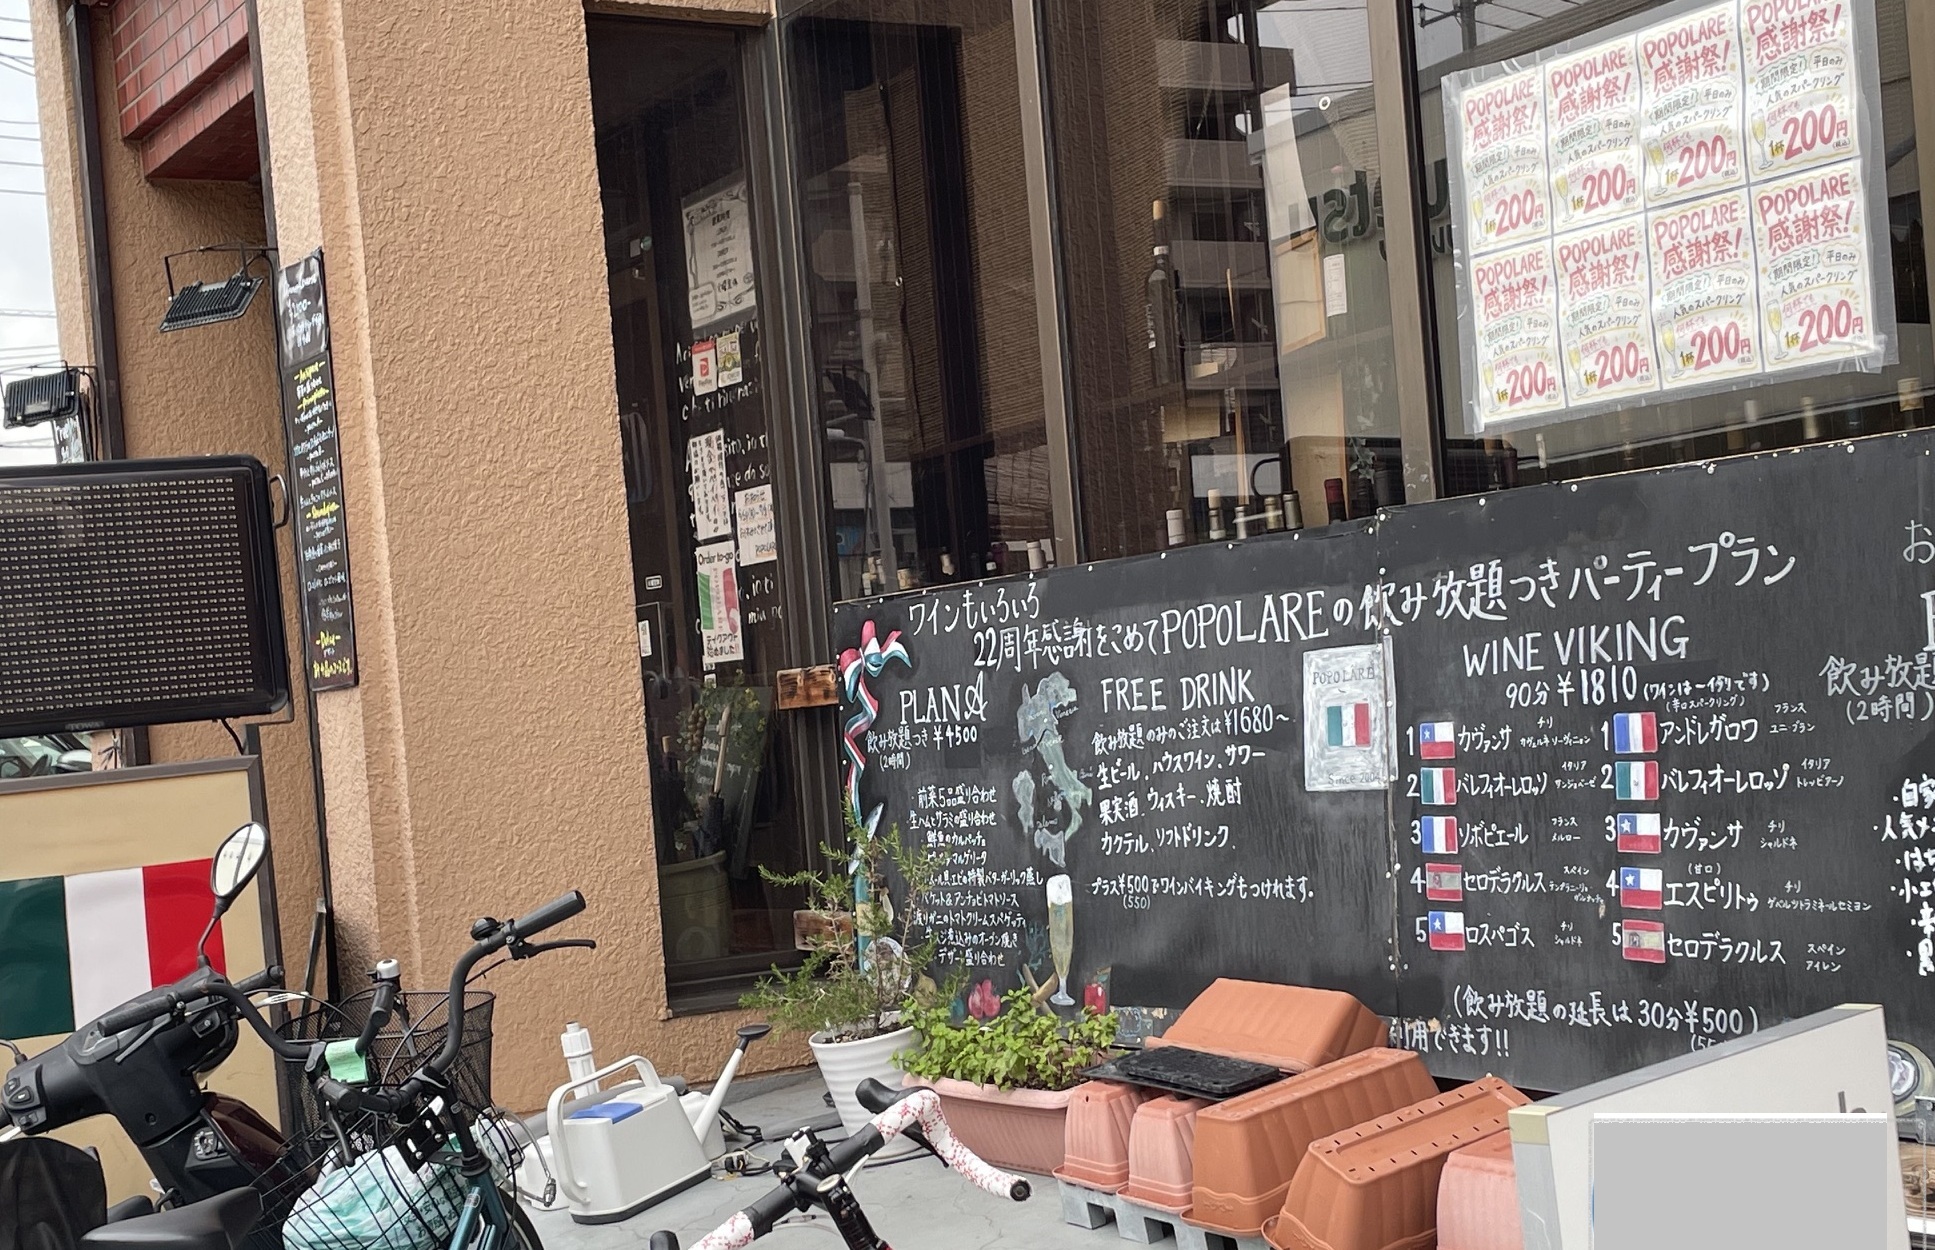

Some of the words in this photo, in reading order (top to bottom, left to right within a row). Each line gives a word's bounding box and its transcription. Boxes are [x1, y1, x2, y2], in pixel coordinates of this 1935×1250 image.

[1643, 13, 1726, 68] POPOLARE
[1756, 4, 1841, 66] 感謝祭!
[1551, 47, 1627, 98] POPOLARE
[1654, 39, 1730, 97] 感謝祭!
[1813, 55, 1844, 68] 平日のみ
[1465, 78, 1535, 126] POPOLARE
[1558, 72, 1631, 127] 感謝祭!
[1704, 89, 1732, 100] 平日のみ
[1766, 73, 1845, 106] 人気のスパークリング
[1473, 101, 1537, 152] 感謝祭!
[1605, 118, 1631, 130] 平日のみ
[1660, 106, 1732, 136] 人気のスパークリング
[1513, 145, 1537, 156] 平日のみ
[1568, 136, 1633, 163] 人気のスパークリング
[1482, 163, 1539, 189] 人気のスパークリング
[1758, 173, 1850, 225] POPOLARE
[1654, 200, 1739, 250] POPOLARE
[1768, 200, 1854, 257] 感謝祭!
[1559, 225, 1635, 273] POPOLARE
[1663, 227, 1743, 280] 感謝祭!
[1826, 250, 1857, 263] 平日のみ
[1475, 251, 1544, 295] POPOLARE
[1569, 251, 1639, 301] 感謝祭!
[1717, 273, 1745, 286] 平日のみ
[1781, 270, 1859, 297] 人気のスパークリング
[1484, 274, 1547, 322] 感謝祭!
[1615, 296, 1640, 308] 平日のみ
[1673, 292, 1746, 318] 人気のスパークリング
[1527, 317, 1549, 329] 平日のみ
[1579, 314, 1641, 339] 人気のスパークリング
[1492, 335, 1549, 358] 人気のスパークリング
[698, 551, 715, 566] Order
[909, 581, 1040, 636] ワインもいろいろ
[706, 633, 739, 645] テイクアウト
[1463, 632, 1544, 677] WINE
[1553, 615, 1690, 665] VIKING
[1100, 677, 1167, 714] FREE
[1180, 665, 1255, 712] DRINK
[1505, 680, 1549, 709] 90分
[1557, 664, 1637, 707] ¥1810
[1644, 671, 1770, 701] (ワインは一例です)
[900, 684, 961, 725] PLAN
[1666, 693, 1746, 713] (辛口スパークリング)
[1774, 702, 1808, 714] フランス
[1846, 690, 1934, 726] (2時間)
[1537, 716, 1553, 729] チリ
[1601, 721, 1609, 751] 1
[1659, 713, 1759, 746] アンドレガロワ
[865, 725, 929, 754] 飲み放題つき
[932, 723, 978, 751] ¥4500
[1406, 726, 1414, 756] 1
[1457, 723, 1513, 753] カヴァンサ
[879, 752, 912, 771] (2時間)
[1561, 760, 1587, 771] イタリア
[1801, 757, 1831, 770] イタリア
[1406, 774, 1420, 797] 2
[1600, 763, 1614, 789] 2
[917, 782, 997, 809] 前菜5品盛り合わせ
[910, 808, 998, 830] 生ハムとサラミの盛り合わせ
[1410, 819, 1422, 845] 3
[1551, 816, 1578, 828] フランス
[1767, 819, 1786, 833] チリ
[1551, 832, 1581, 842] メルロー
[1604, 815, 1616, 842] 3
[1663, 816, 1744, 851] カヴァンサ
[1760, 836, 1799, 850] シャルドネ
[1410, 866, 1426, 894] 4
[1463, 864, 1546, 894] セロデラクルス
[1563, 865, 1590, 876] スペイン
[1688, 862, 1722, 876] (甘口)
[1605, 870, 1620, 897] 4
[1663, 878, 1760, 912] エスピリトゥ
[1784, 880, 1801, 894] チリ
[1122, 894, 1151, 910] (550)
[1416, 917, 1428, 943] 5
[1465, 921, 1535, 948] ロスパゴス
[1560, 921, 1574, 932] チリ
[1554, 934, 1583, 948] シャルドネ
[1612, 923, 1622, 947] 5
[1667, 930, 1787, 965] セロデラクルス
[1807, 943, 1846, 956] スペイン
[1805, 960, 1842, 973] アイレン
